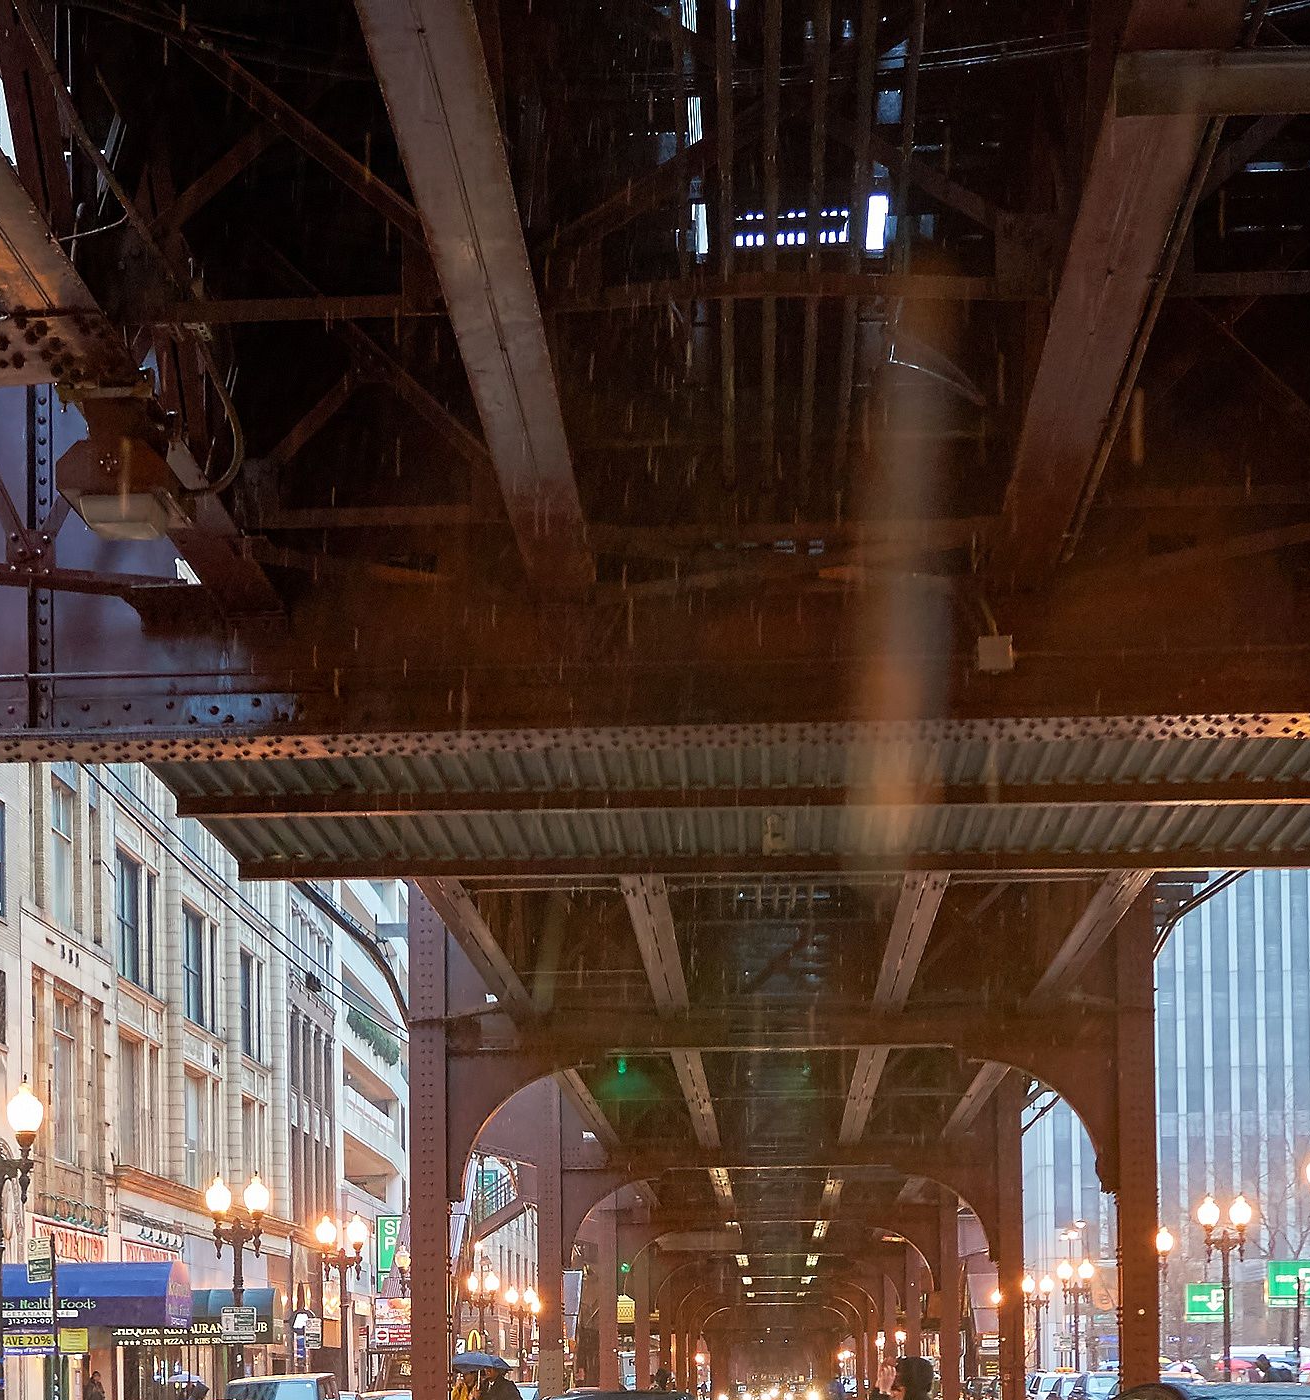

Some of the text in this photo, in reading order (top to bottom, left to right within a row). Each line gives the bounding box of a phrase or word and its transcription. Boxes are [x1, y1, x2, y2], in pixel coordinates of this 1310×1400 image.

[60, 1298, 97, 1310] Foods
[8, 1318, 56, 1326] 312-922-00
[163, 1323, 223, 1337] RESTAURAN
[3, 1335, 52, 1346] AVE 20%
[164, 1338, 184, 1346] PIZZA
